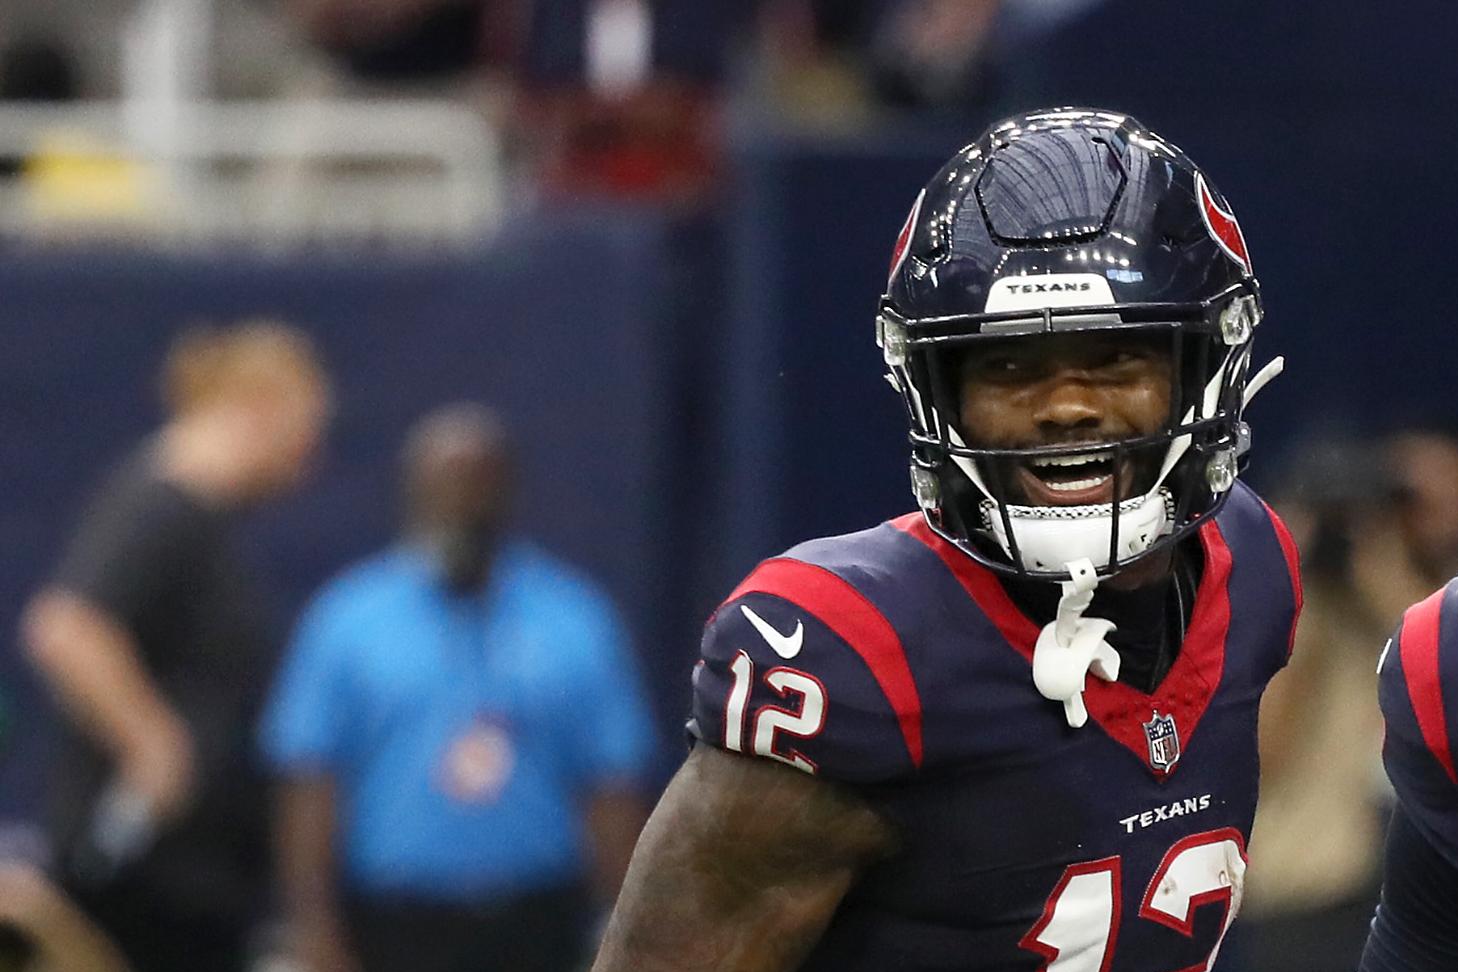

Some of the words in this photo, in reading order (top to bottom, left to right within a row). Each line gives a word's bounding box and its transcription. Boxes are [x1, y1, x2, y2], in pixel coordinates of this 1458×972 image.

[1006, 283, 1090, 294] TEXANS
[723, 649, 829, 775] 12
[1119, 794, 1212, 833] TEXANS
